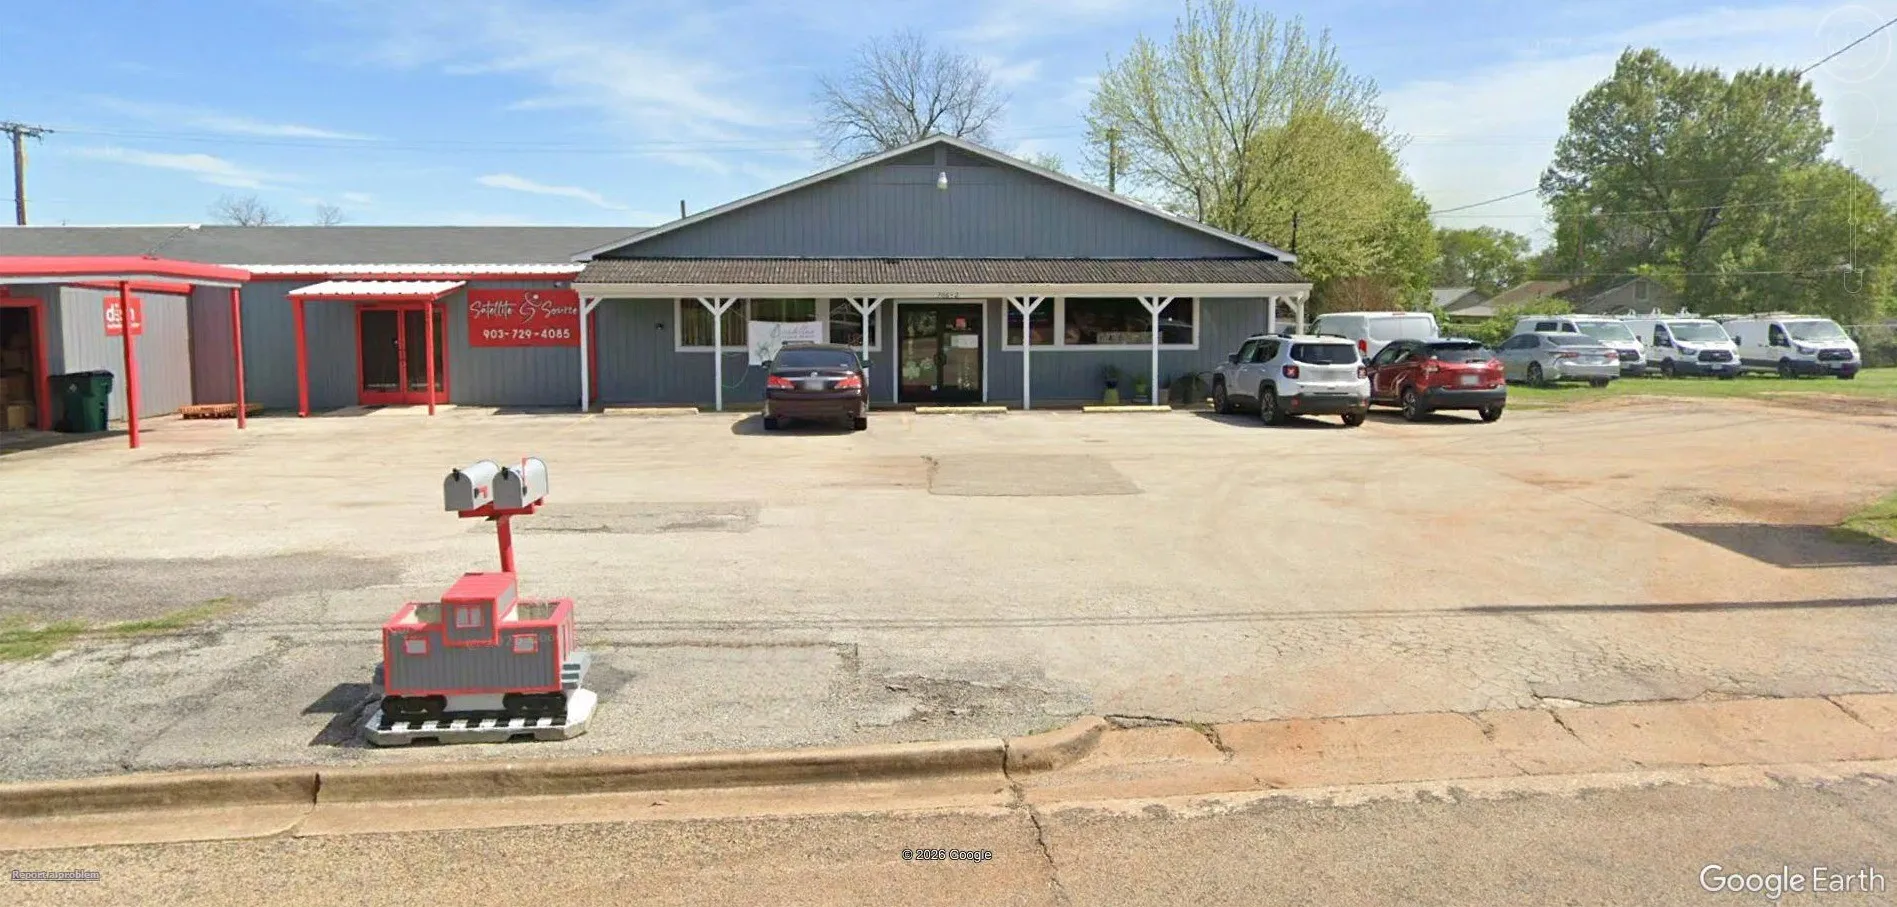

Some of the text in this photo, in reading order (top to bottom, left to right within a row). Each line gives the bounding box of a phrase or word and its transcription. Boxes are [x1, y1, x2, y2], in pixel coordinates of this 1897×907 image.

[469, 300, 578, 320] Satellite Source
[483, 328, 570, 339] 903-729-4085
